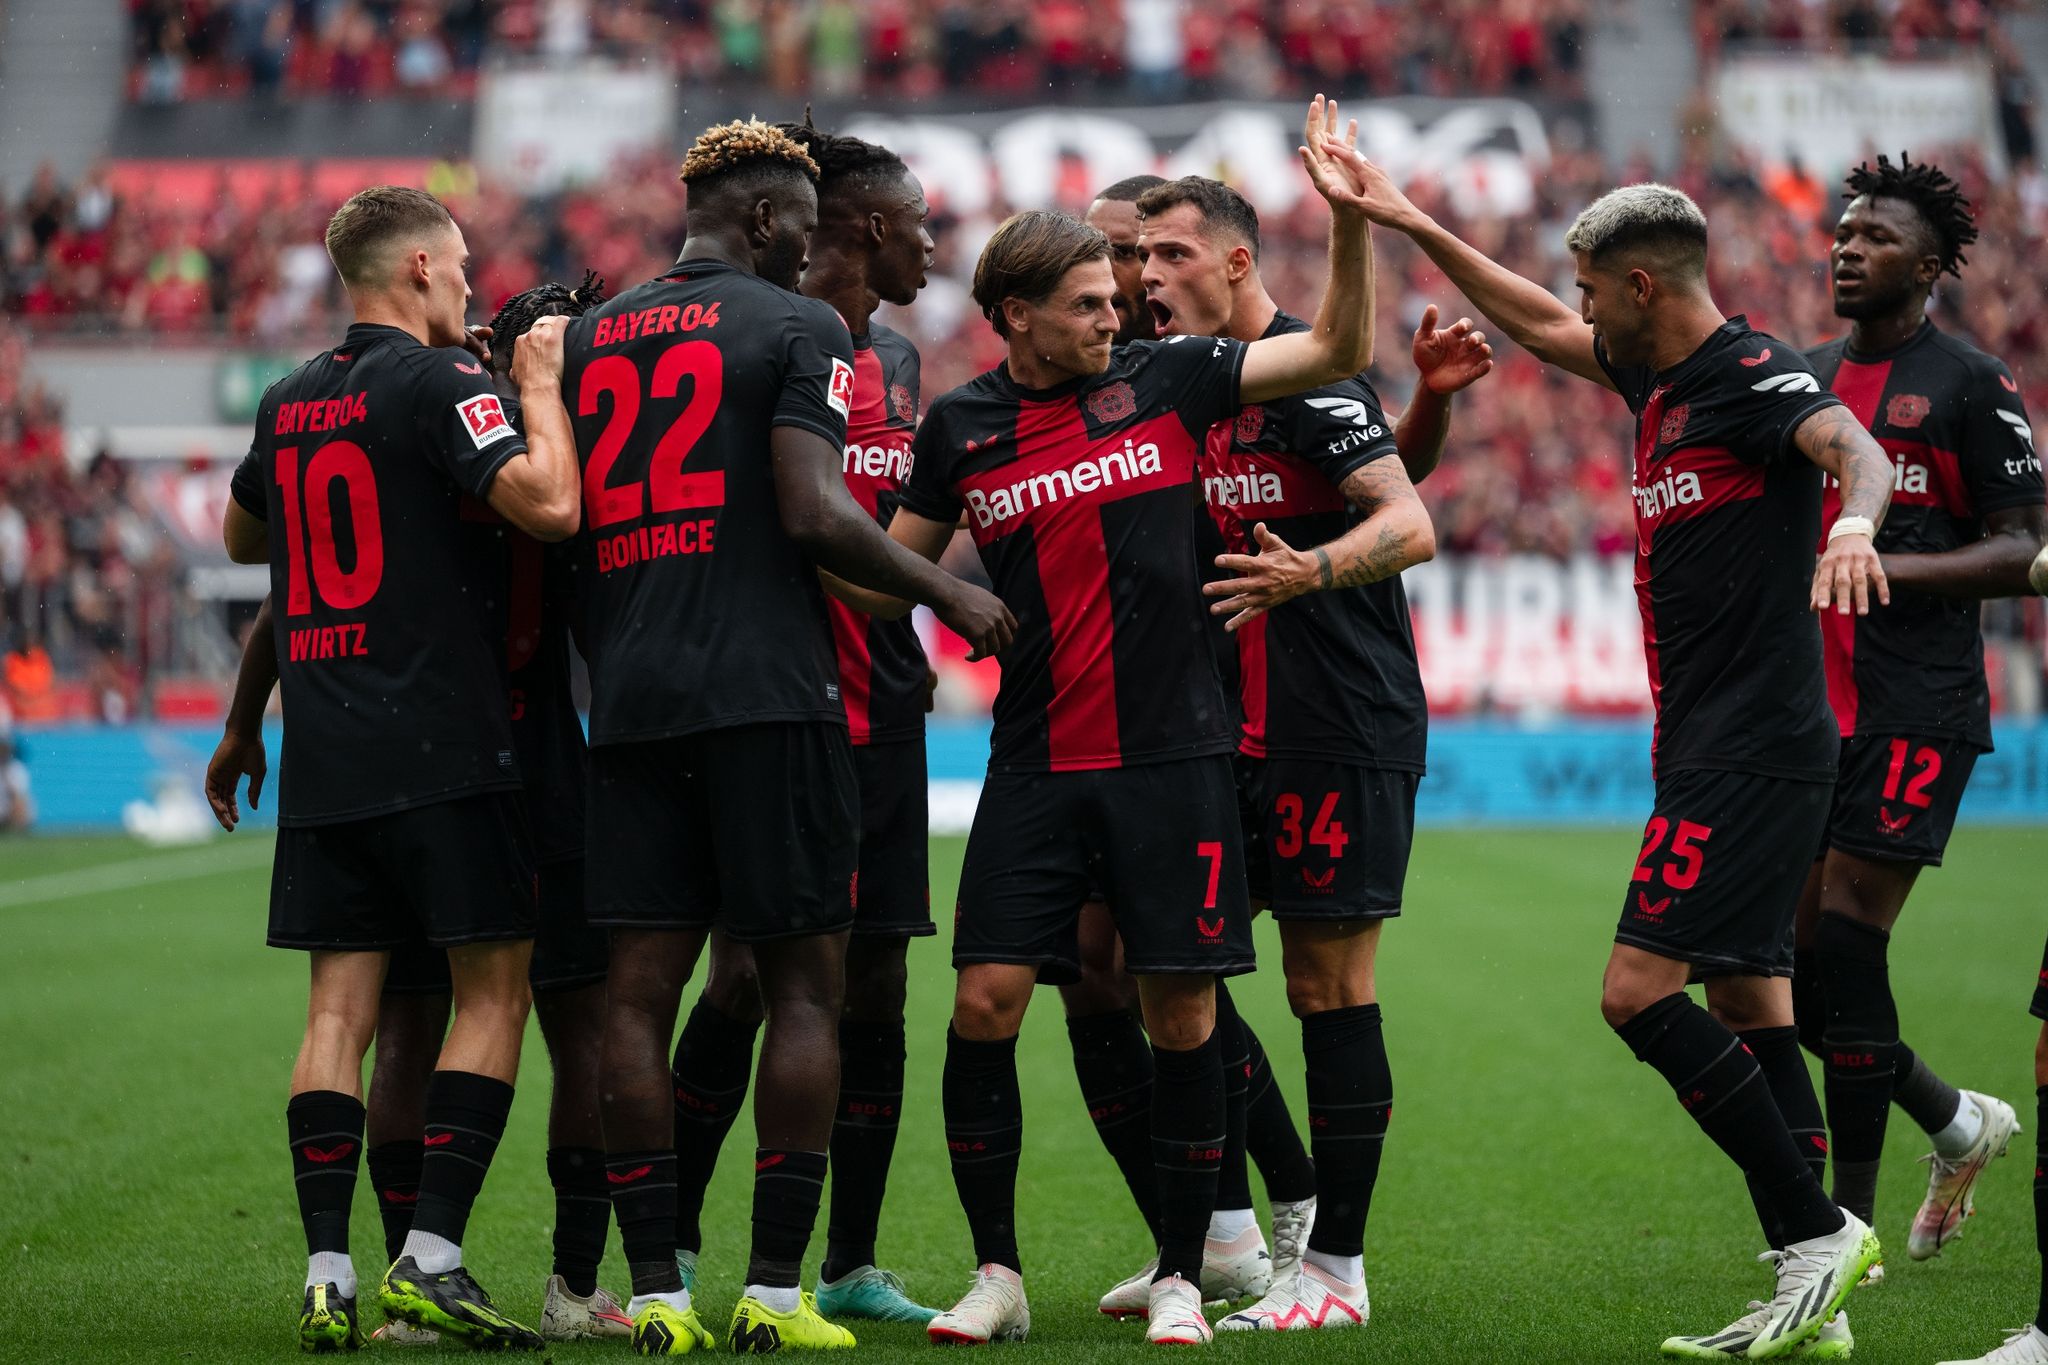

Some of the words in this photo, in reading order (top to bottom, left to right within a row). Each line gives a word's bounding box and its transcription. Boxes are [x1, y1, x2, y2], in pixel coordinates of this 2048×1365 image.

[578, 340, 725, 532] 22
[1328, 424, 1383, 454] trive
[965, 439, 1163, 529] Barmenia
[275, 440, 384, 616] 10
[597, 519, 715, 573] BONIFACE
[290, 623, 368, 663] WIRTZ
[1883, 737, 1942, 808] 12
[1275, 792, 1348, 858] 34
[1632, 816, 1712, 890] 25
[1197, 842, 1222, 908] 7
